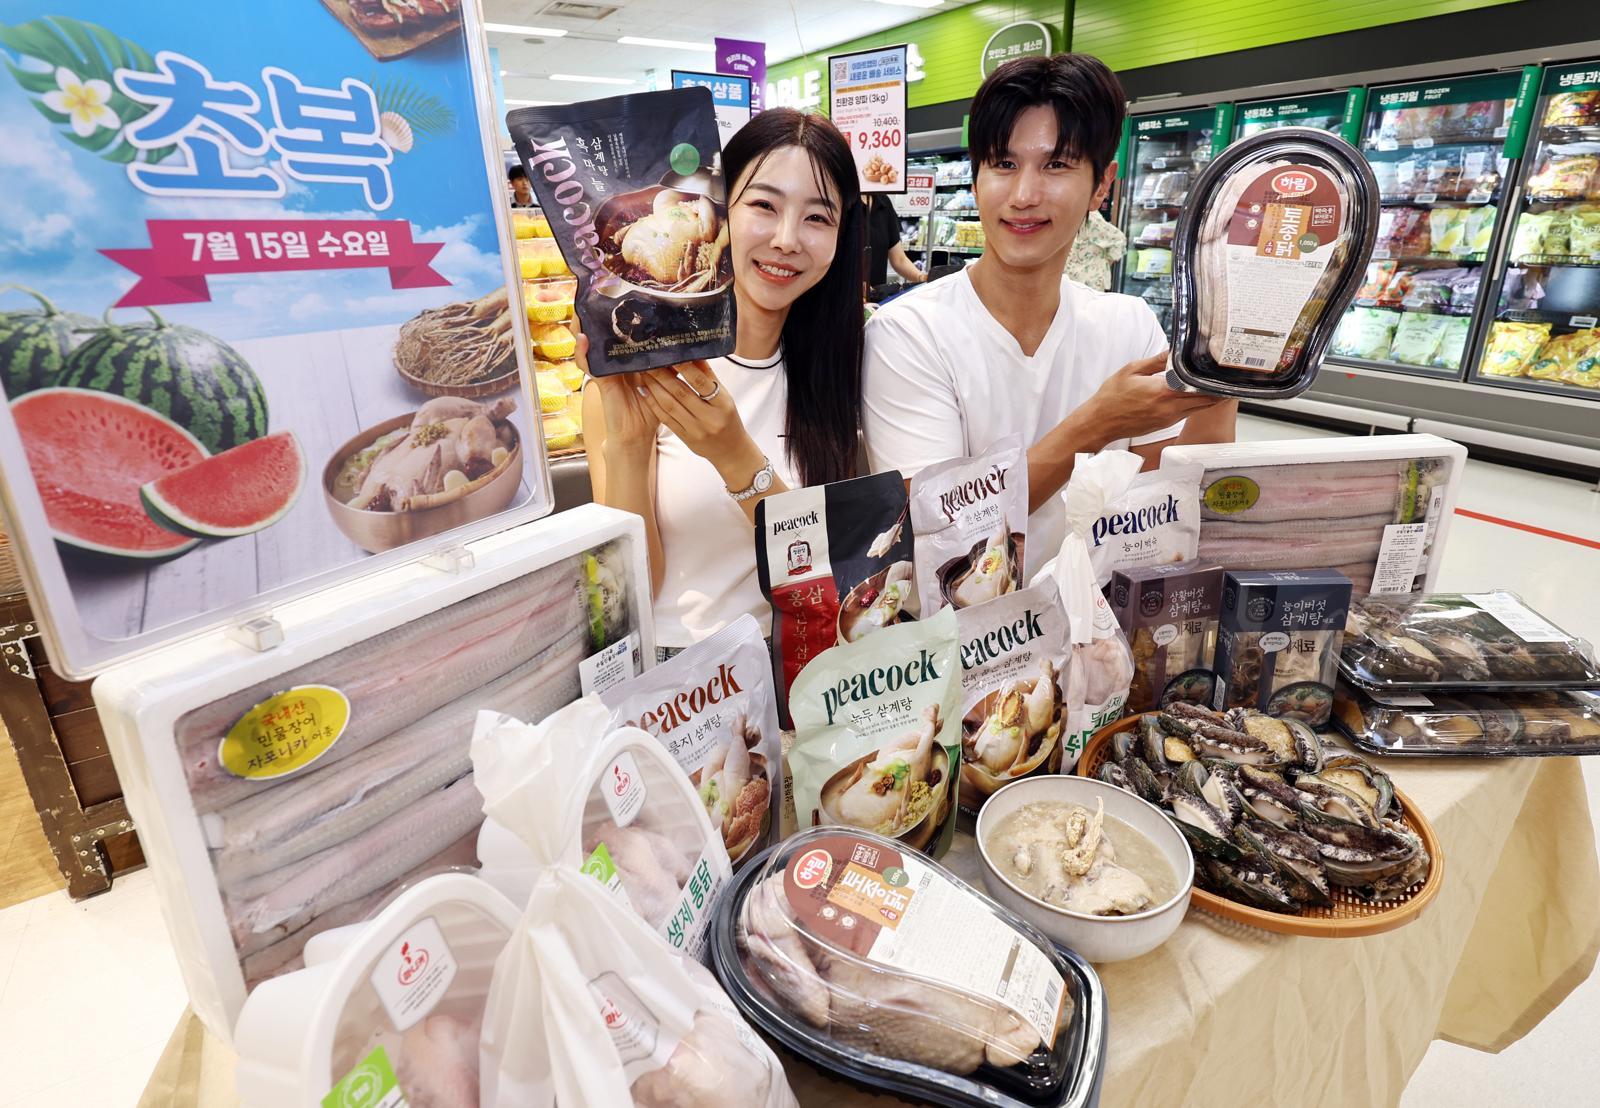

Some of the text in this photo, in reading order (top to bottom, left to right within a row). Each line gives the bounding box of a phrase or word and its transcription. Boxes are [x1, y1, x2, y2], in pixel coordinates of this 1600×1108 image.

[869, 92, 888, 105] (3kg)
[1380, 91, 1419, 105] 냉동과일
[1244, 108, 1274, 119] 냉동채소
[113, 50, 395, 210] 초복
[858, 129, 901, 150] 9,360
[907, 177, 929, 187] 고상품
[1280, 177, 1308, 191] 하림
[528, 135, 623, 292] peacock
[183, 229, 390, 262] 7월 15일 수요일
[1275, 207, 1303, 257] 토종닭
[939, 465, 1008, 524] peacock
[773, 511, 819, 536] peacock
[974, 504, 999, 522] 삼계탕
[1092, 494, 1180, 547] peacock
[1168, 599, 1202, 618] 삼계탕
[1280, 611, 1323, 626] 삼계탕
[1282, 600, 1327, 612] 능이버섯
[960, 609, 1046, 670] eacock
[1180, 621, 1203, 636] 재료
[622, 664, 743, 737] eacock
[821, 649, 942, 726] peacock
[851, 697, 913, 725] 녹두 삼계탕
[257, 713, 316, 748] 민물장어
[669, 733, 693, 755] 룽지
[695, 714, 722, 741] 삼계탕
[248, 736, 308, 769] 자포니카
[799, 855, 826, 880] 하림
[667, 898, 694, 948] 생제
[689, 858, 712, 910] 통닭
[841, 869, 909, 912] 토종닭
